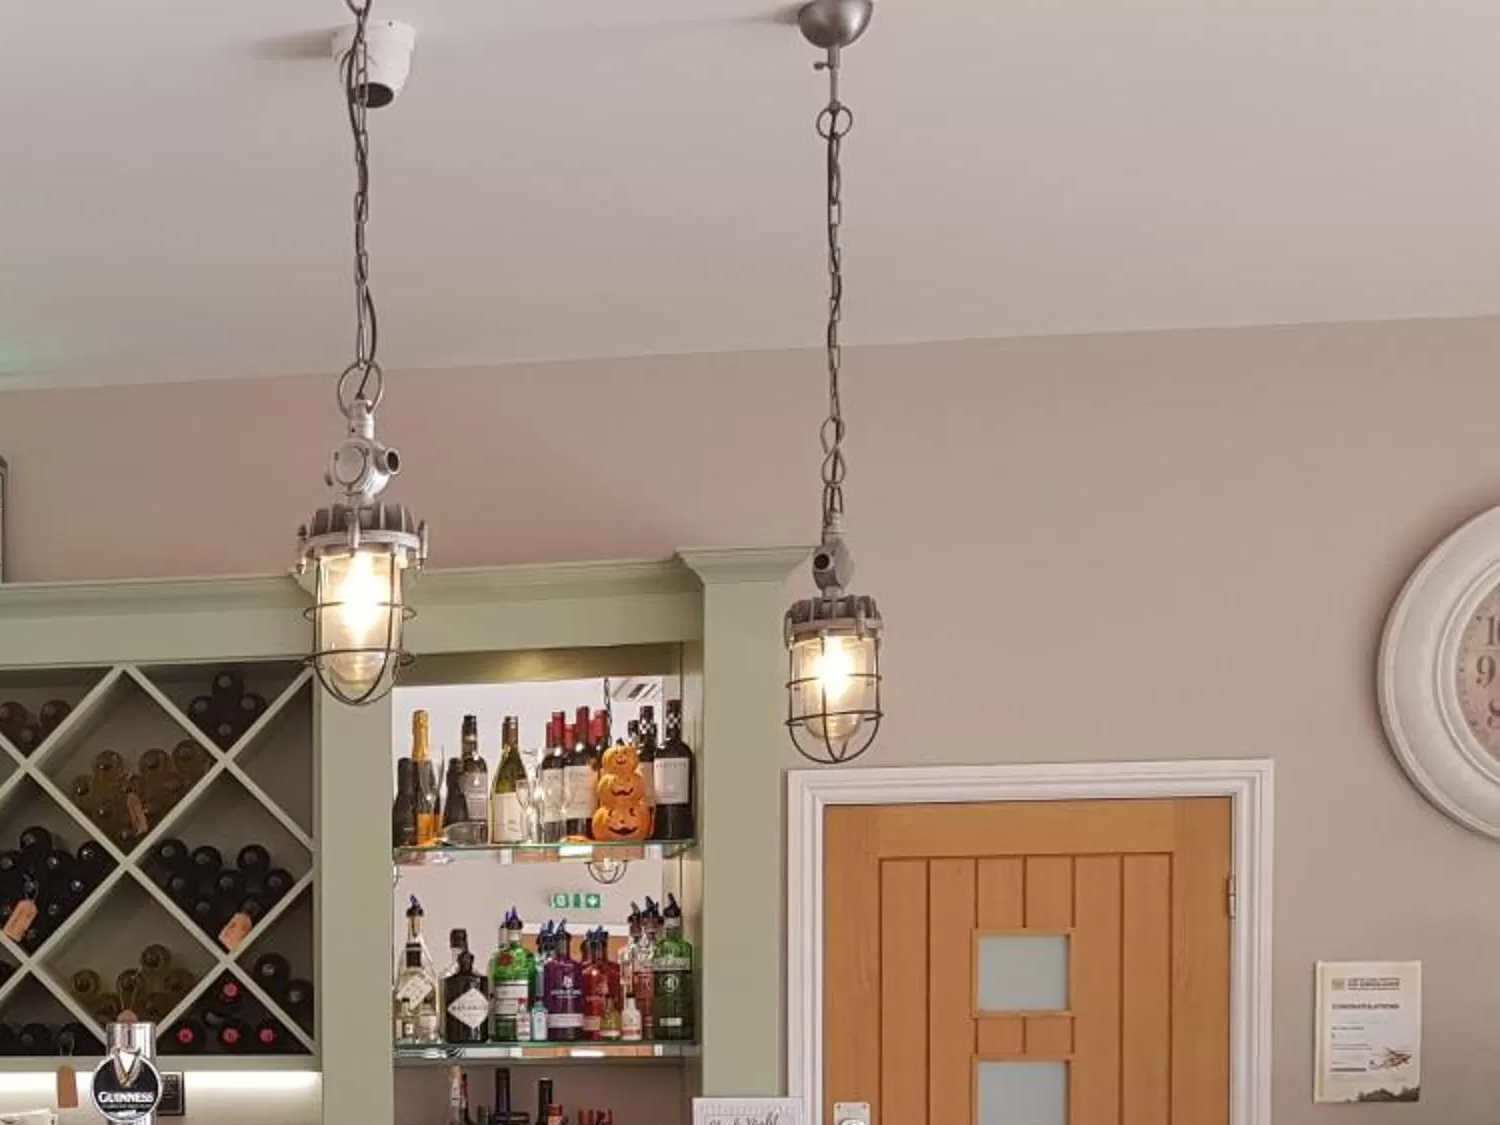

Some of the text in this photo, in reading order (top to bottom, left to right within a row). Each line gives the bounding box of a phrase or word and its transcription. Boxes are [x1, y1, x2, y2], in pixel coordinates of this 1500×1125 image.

[1486, 614, 1500, 645] 1
[1476, 655, 1496, 688] 9
[97, 1091, 154, 1103] GUINNESS
